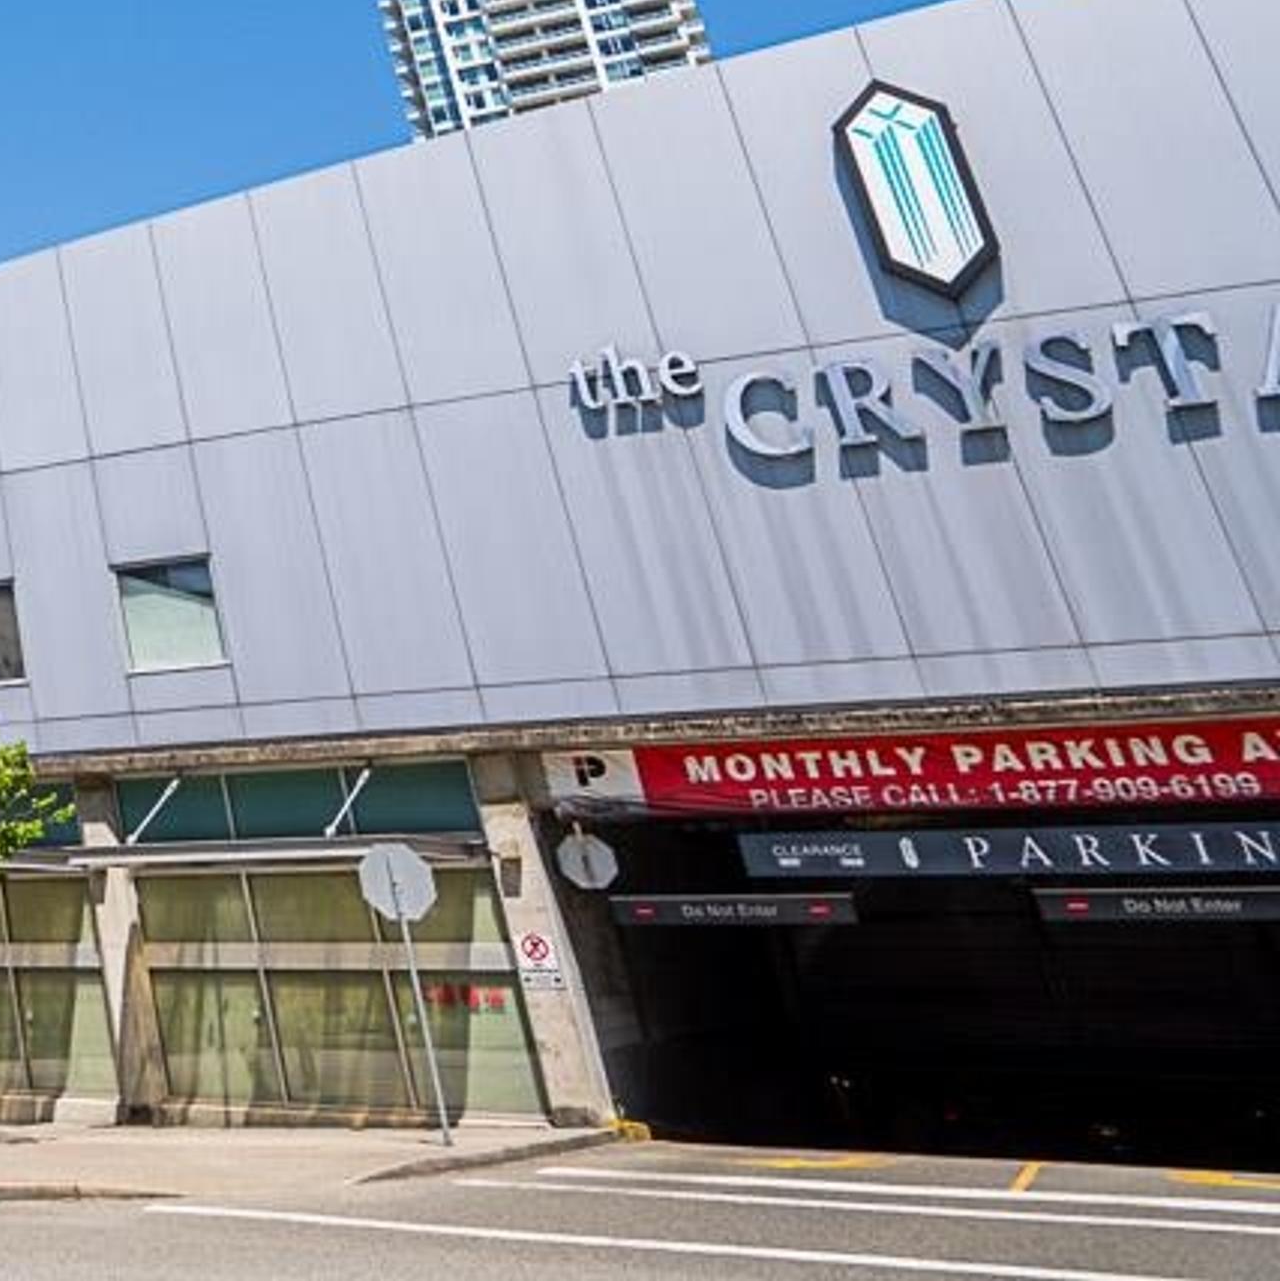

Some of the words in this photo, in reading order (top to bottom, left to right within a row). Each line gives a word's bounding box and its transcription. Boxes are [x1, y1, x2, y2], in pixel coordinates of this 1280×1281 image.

[568, 344, 703, 409] the
[682, 745, 926, 784] MONTHLY
[950, 734, 1214, 774] PARKING
[1241, 731, 1280, 762] A
[749, 785, 871, 809] PLEASE
[989, 772, 1262, 805] 1-877-909-6199
[772, 843, 862, 857] CLEARANCE
[1122, 898, 1151, 914] Do
[1153, 897, 1188, 913] Not
[1190, 896, 1241, 913] Enter
